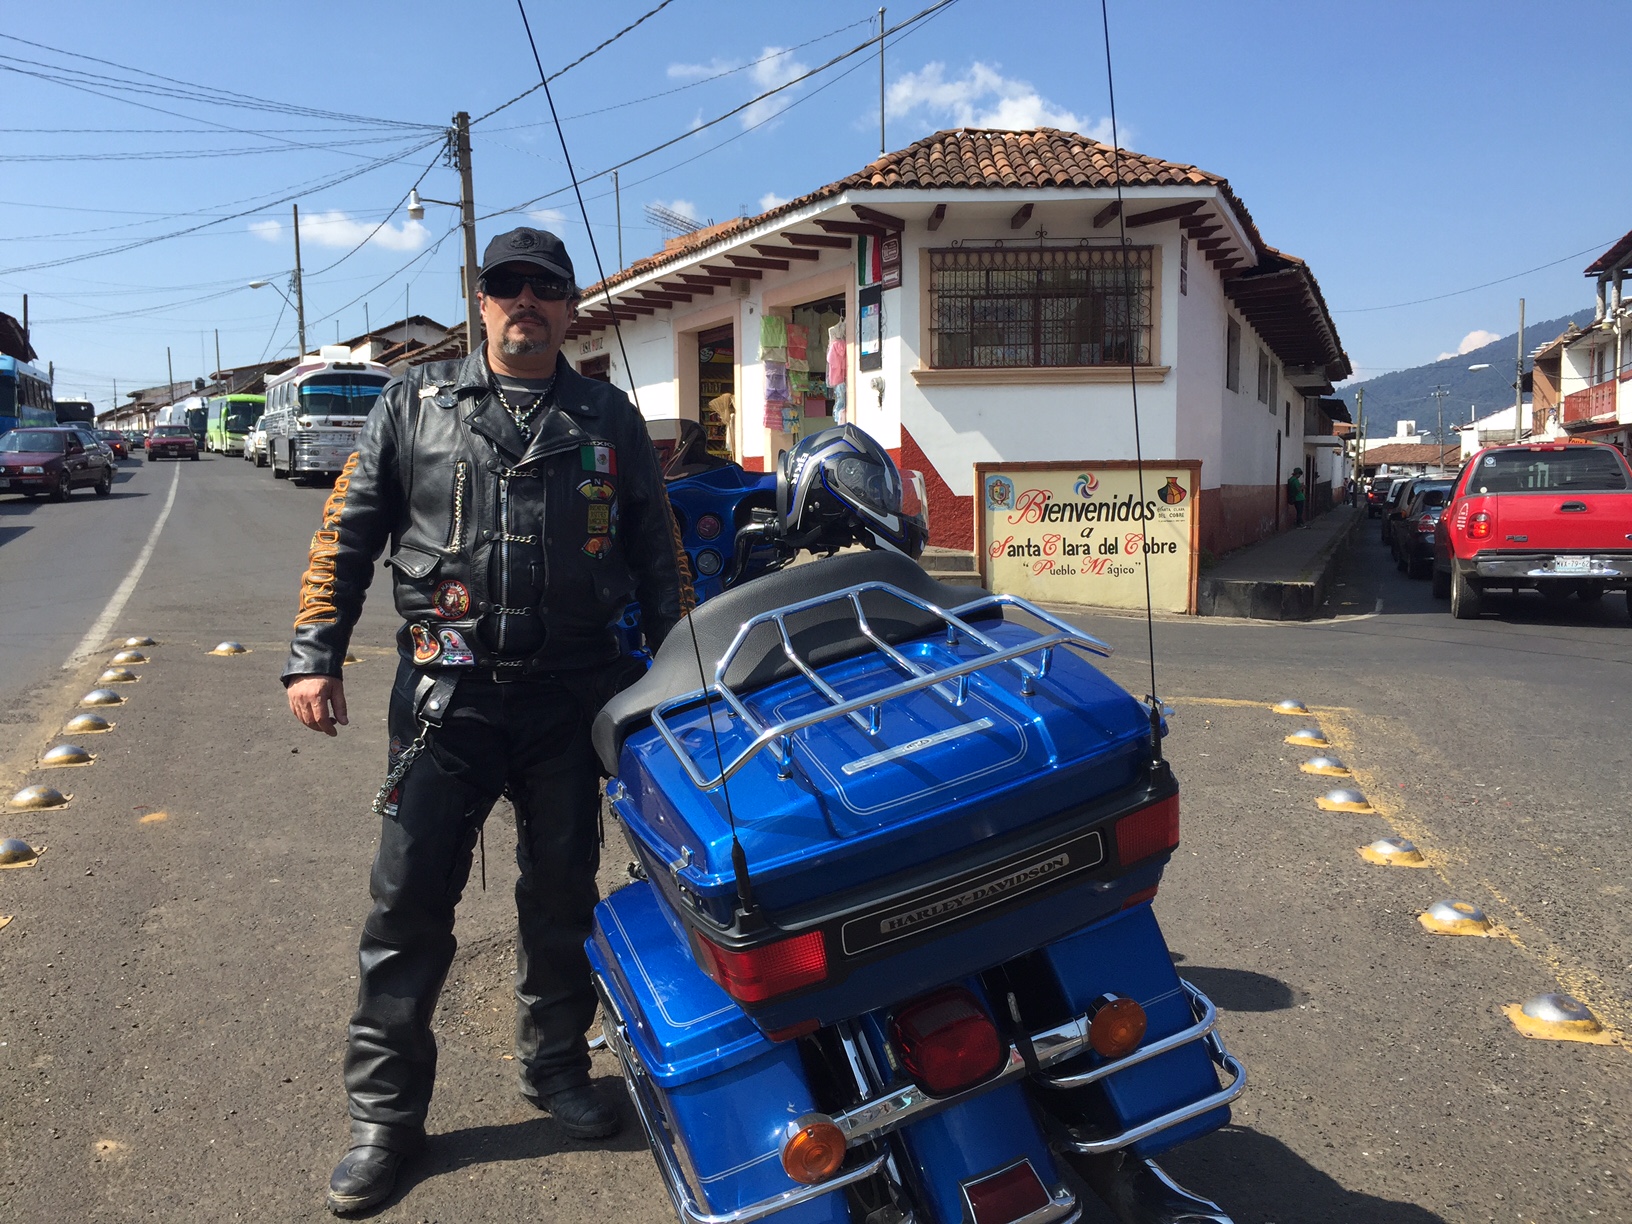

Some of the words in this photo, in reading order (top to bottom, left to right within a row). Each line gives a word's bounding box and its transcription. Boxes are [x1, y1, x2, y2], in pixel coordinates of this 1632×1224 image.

[1008, 488, 1156, 524] Bienvenidos
[989, 535, 1041, 561] Santa
[1042, 533, 1090, 556] Clara
[1098, 537, 1118, 555] del
[1124, 532, 1177, 555] Cobre
[1080, 526, 1094, 539] a
[888, 857, 1064, 930] HARLEY-DAVIDSON
